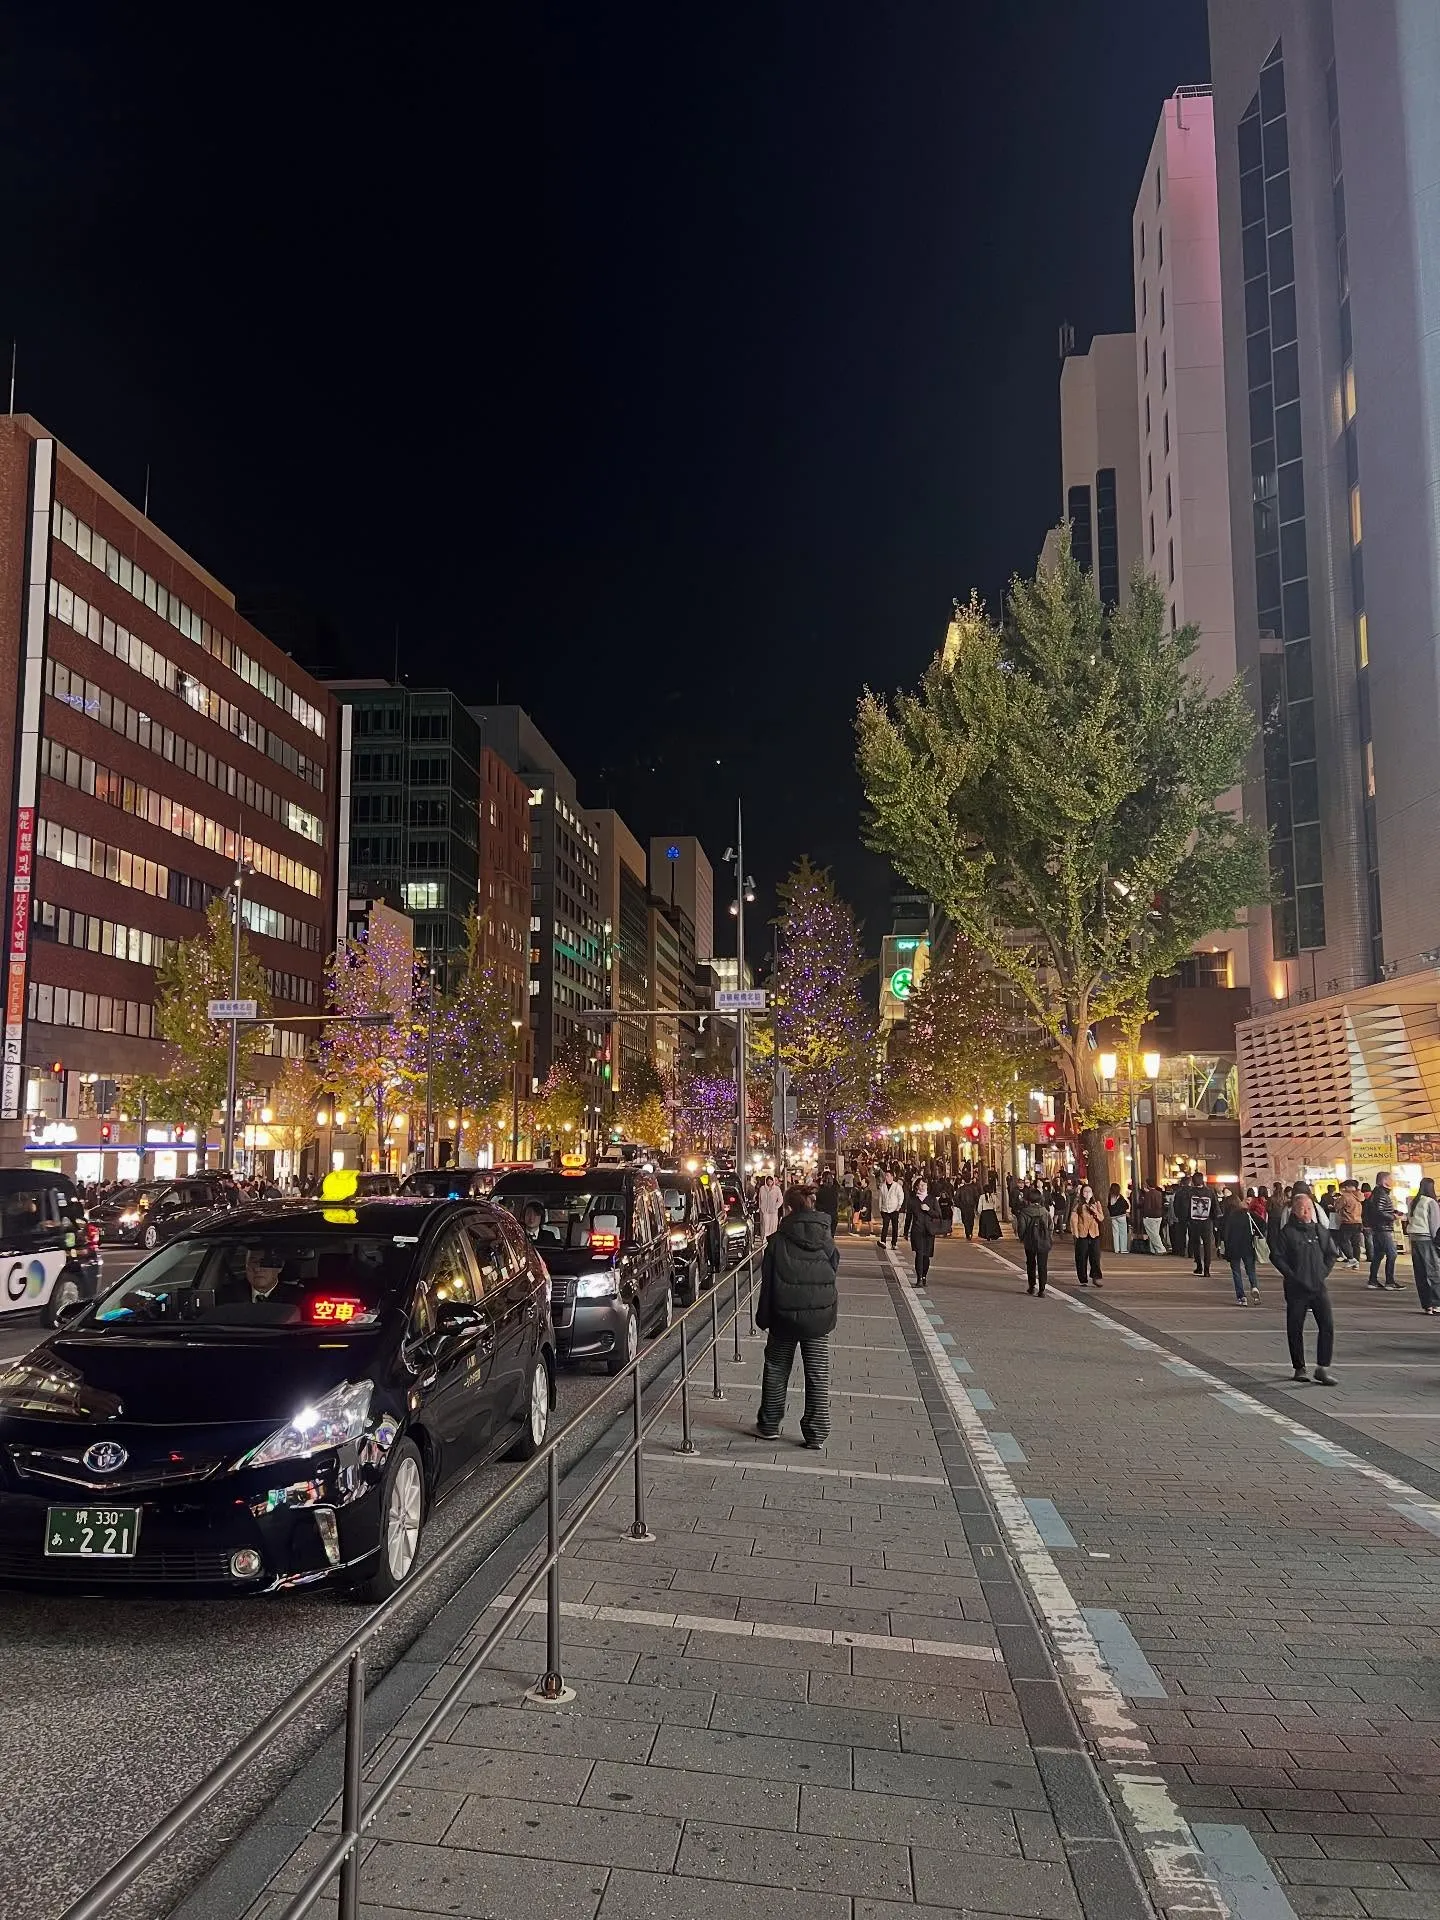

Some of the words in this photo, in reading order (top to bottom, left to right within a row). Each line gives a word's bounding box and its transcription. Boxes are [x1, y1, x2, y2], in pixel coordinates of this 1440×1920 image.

[8, 1259, 45, 1301] GO
[313, 1301, 356, 1321] 空車
[75, 1511, 88, 1524] 堺
[95, 1511, 118, 1525] 330
[51, 1532, 63, 1546] あ
